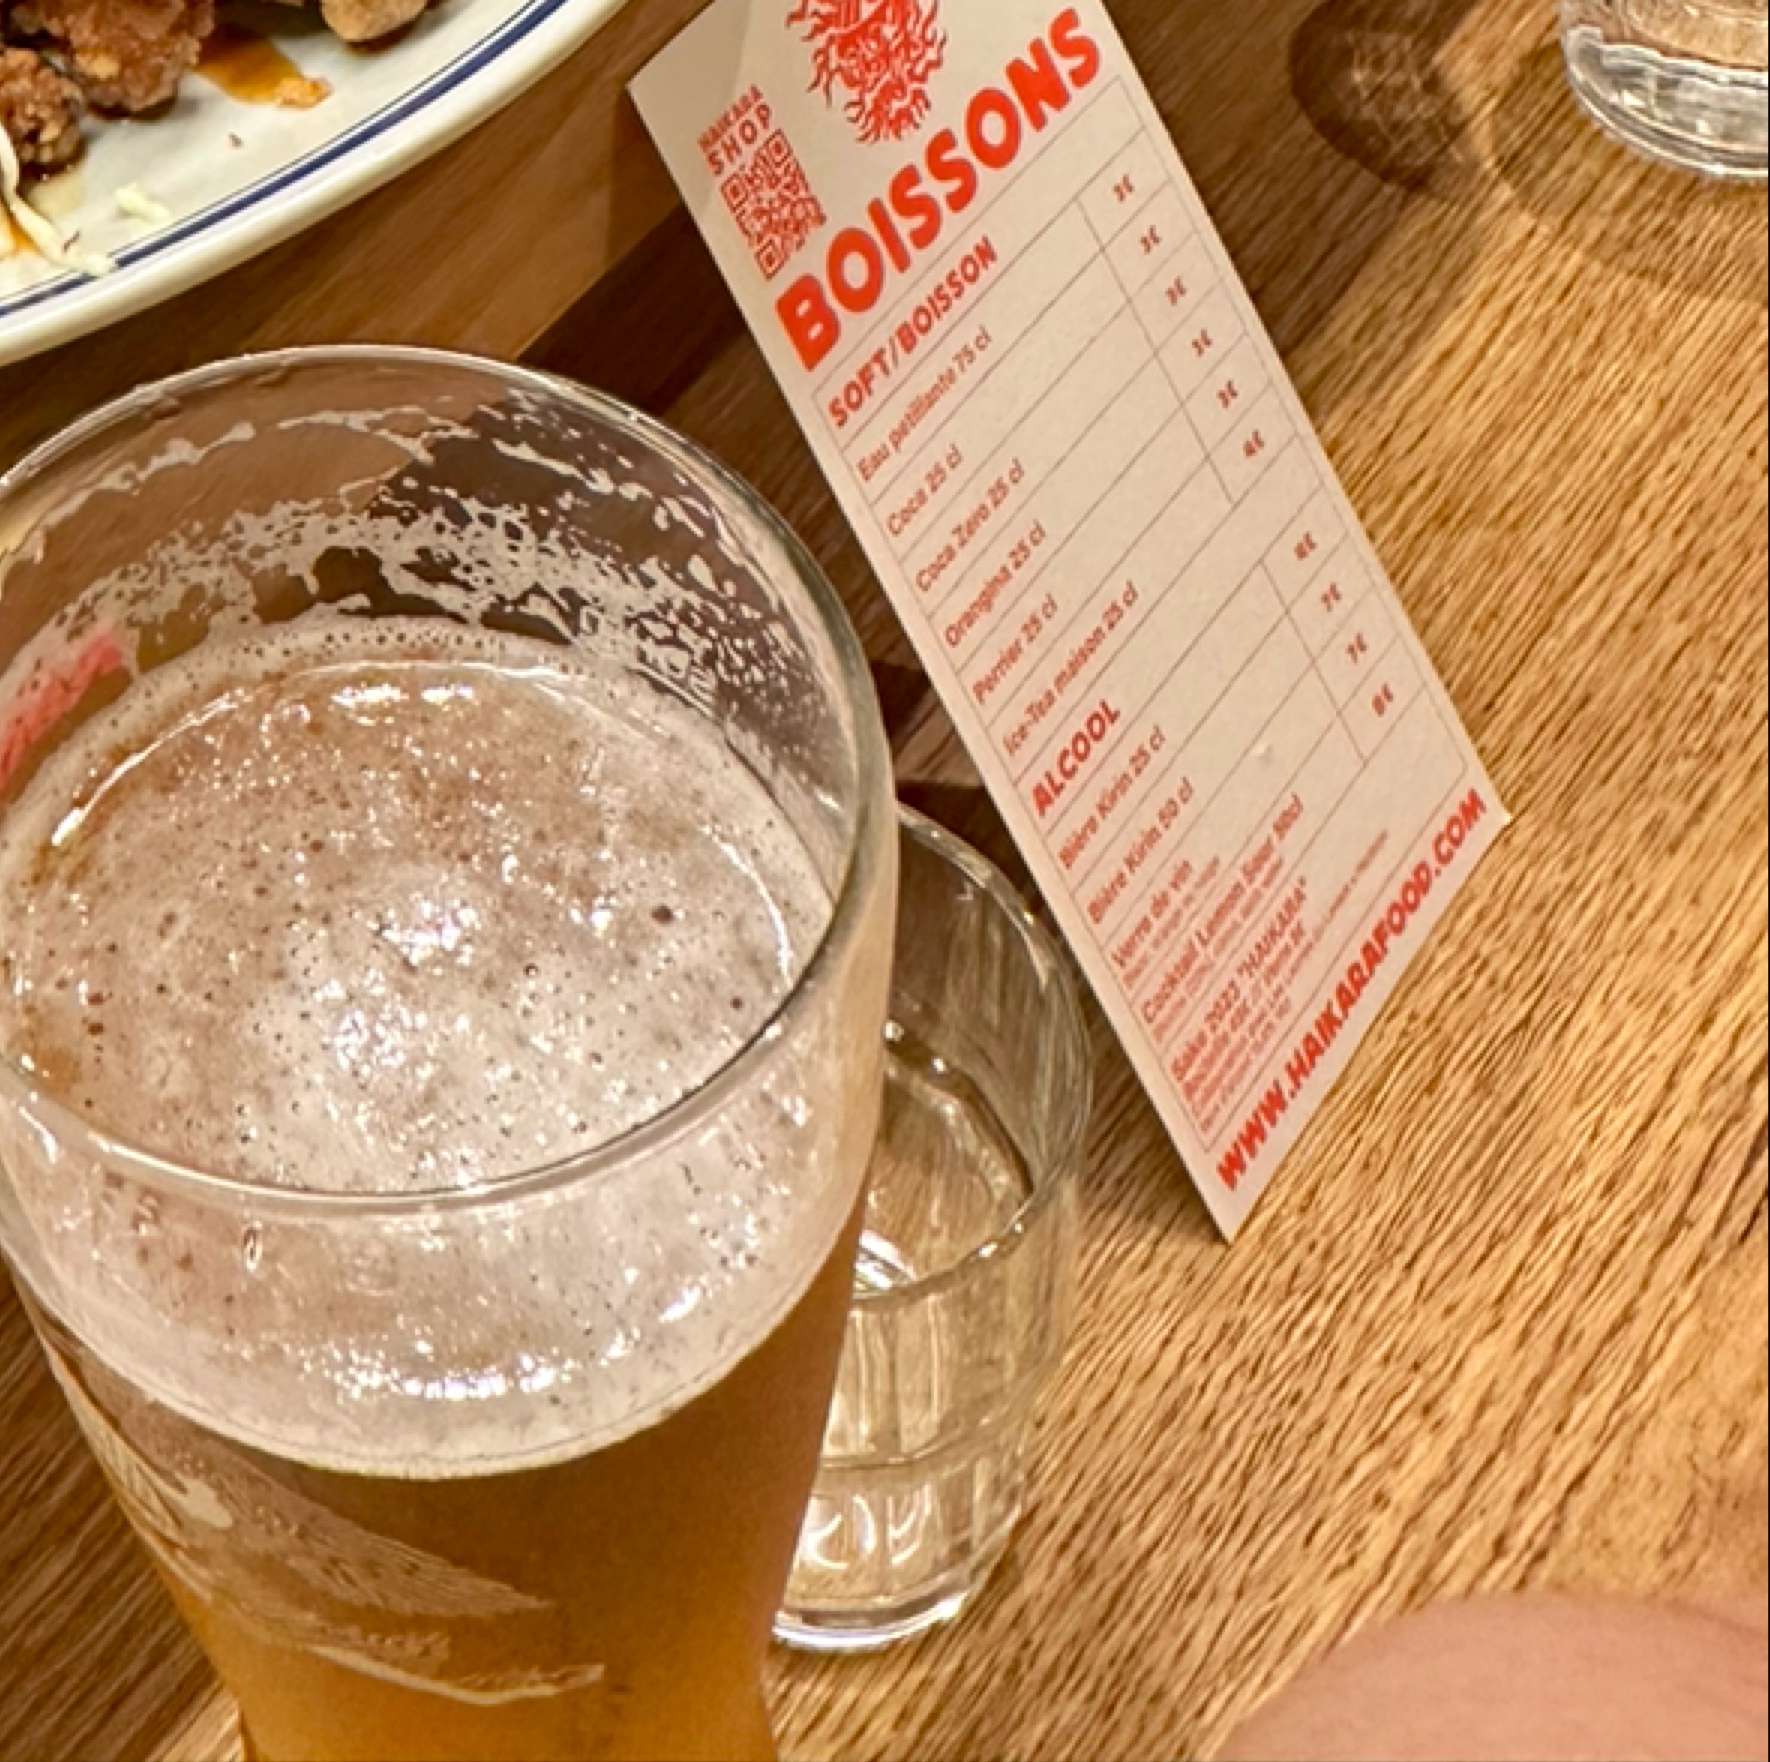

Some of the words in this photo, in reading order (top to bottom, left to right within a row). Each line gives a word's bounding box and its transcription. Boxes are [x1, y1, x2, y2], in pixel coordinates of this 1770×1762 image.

[706, 103, 772, 177] SHOP
[775, 9, 1099, 372] BOISSONS
[829, 237, 997, 428] SOFT/BOISSON
[856, 444, 891, 483] Eau
[952, 344, 976, 372] 75
[974, 325, 991, 351] cl
[886, 489, 928, 537] Coca
[925, 462, 946, 494] 25
[946, 444, 963, 471] cl
[916, 544, 957, 592] Coca
[952, 504, 991, 549] Zero
[988, 477, 1009, 510] 25
[1009, 458, 1024, 485] cl
[945, 564, 1012, 648] Orangina
[1009, 540, 1030, 570] 25
[1029, 519, 1045, 546] cl
[1054, 627, 1105, 694] maison
[1102, 601, 1123, 631] 25
[1123, 581, 1138, 608] cl
[973, 638, 1023, 705] Perrier
[1021, 613, 1042, 644] 25
[1042, 593, 1057, 621] cl
[1033, 700, 1120, 817] ALCOOL
[1096, 772, 1133, 819] Kirin
[1129, 744, 1150, 777] 25
[1150, 725, 1165, 752] cl
[1123, 826, 1162, 874] Kirin
[1158, 798, 1180, 831] 50
[1177, 777, 1194, 804] cl
[1150, 891, 1171, 920] de
[1168, 860, 1192, 891] vin
[1216, 789, 1486, 1191] WWW.HAIKARAFOOD.COM
